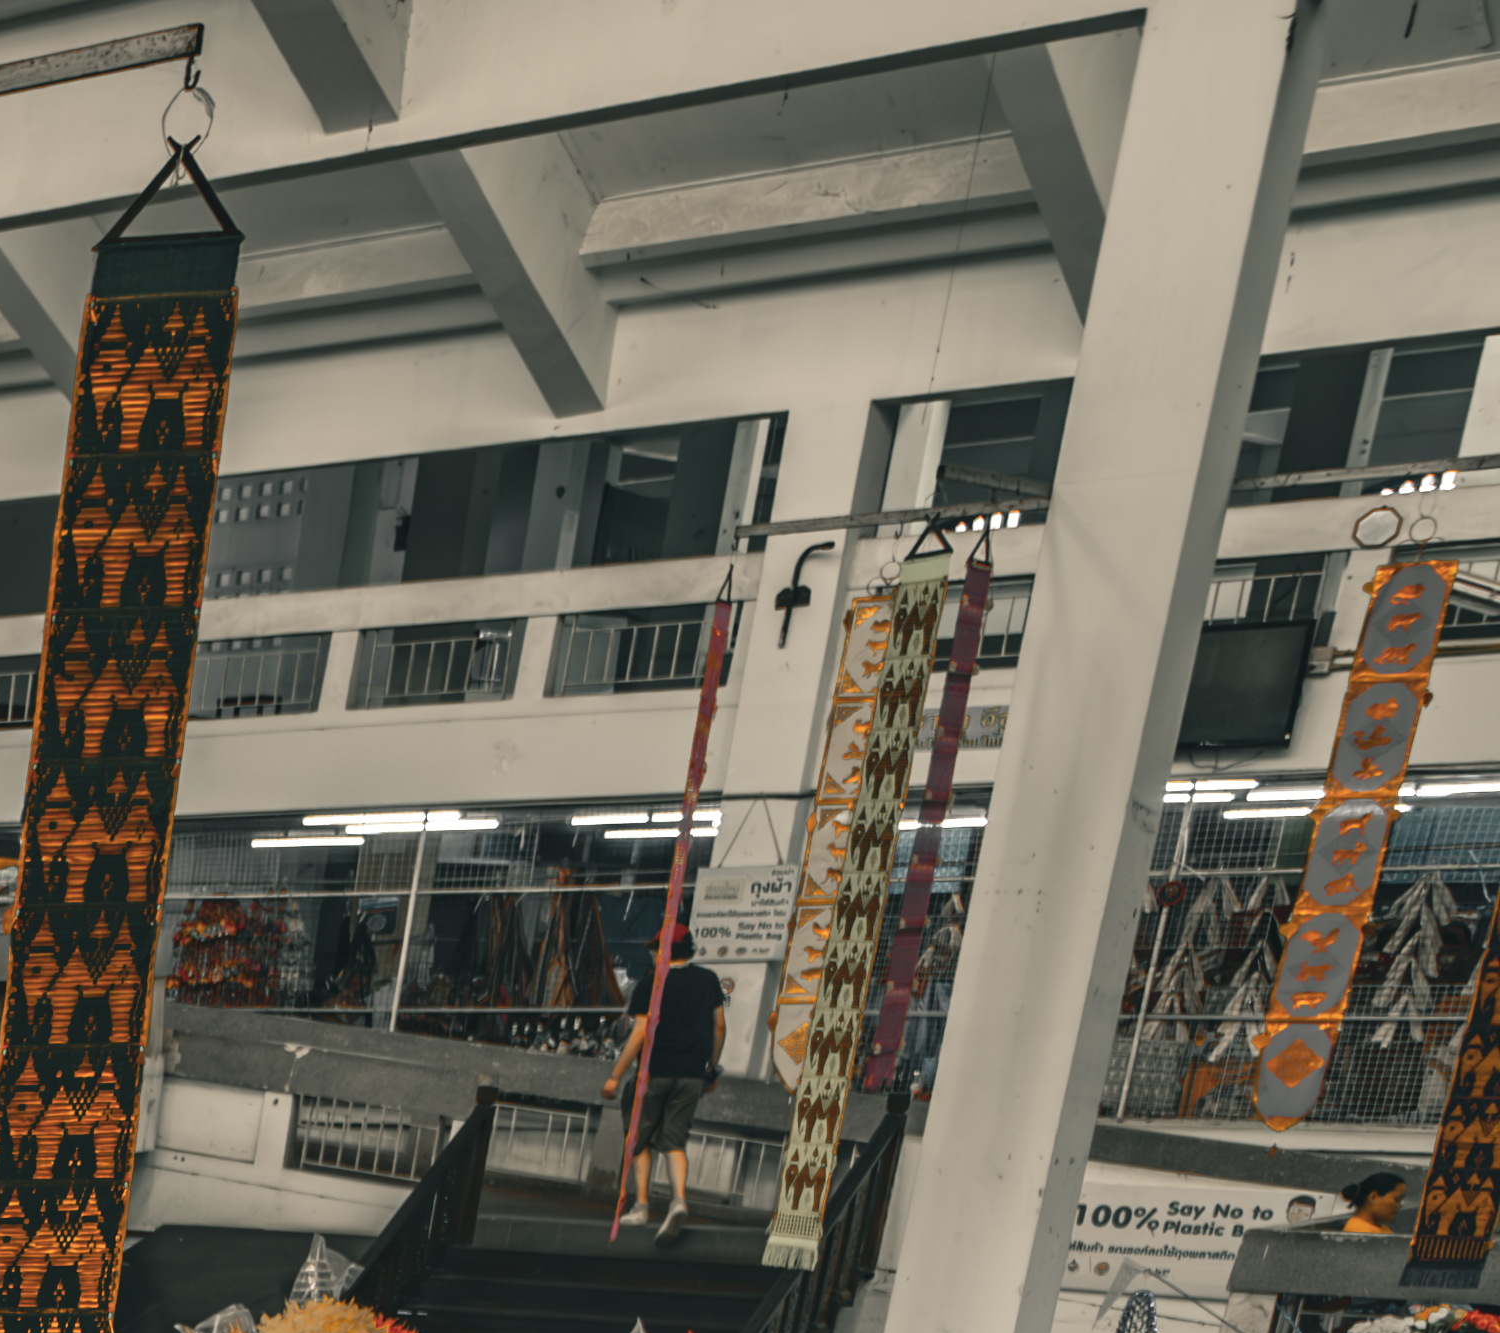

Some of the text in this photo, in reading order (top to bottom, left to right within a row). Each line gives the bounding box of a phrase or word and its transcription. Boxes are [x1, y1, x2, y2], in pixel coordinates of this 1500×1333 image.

[1076, 1204, 1160, 1231] 100%
[1167, 1200, 1274, 1221] Say No to
[1163, 1219, 1226, 1238] Plastic
